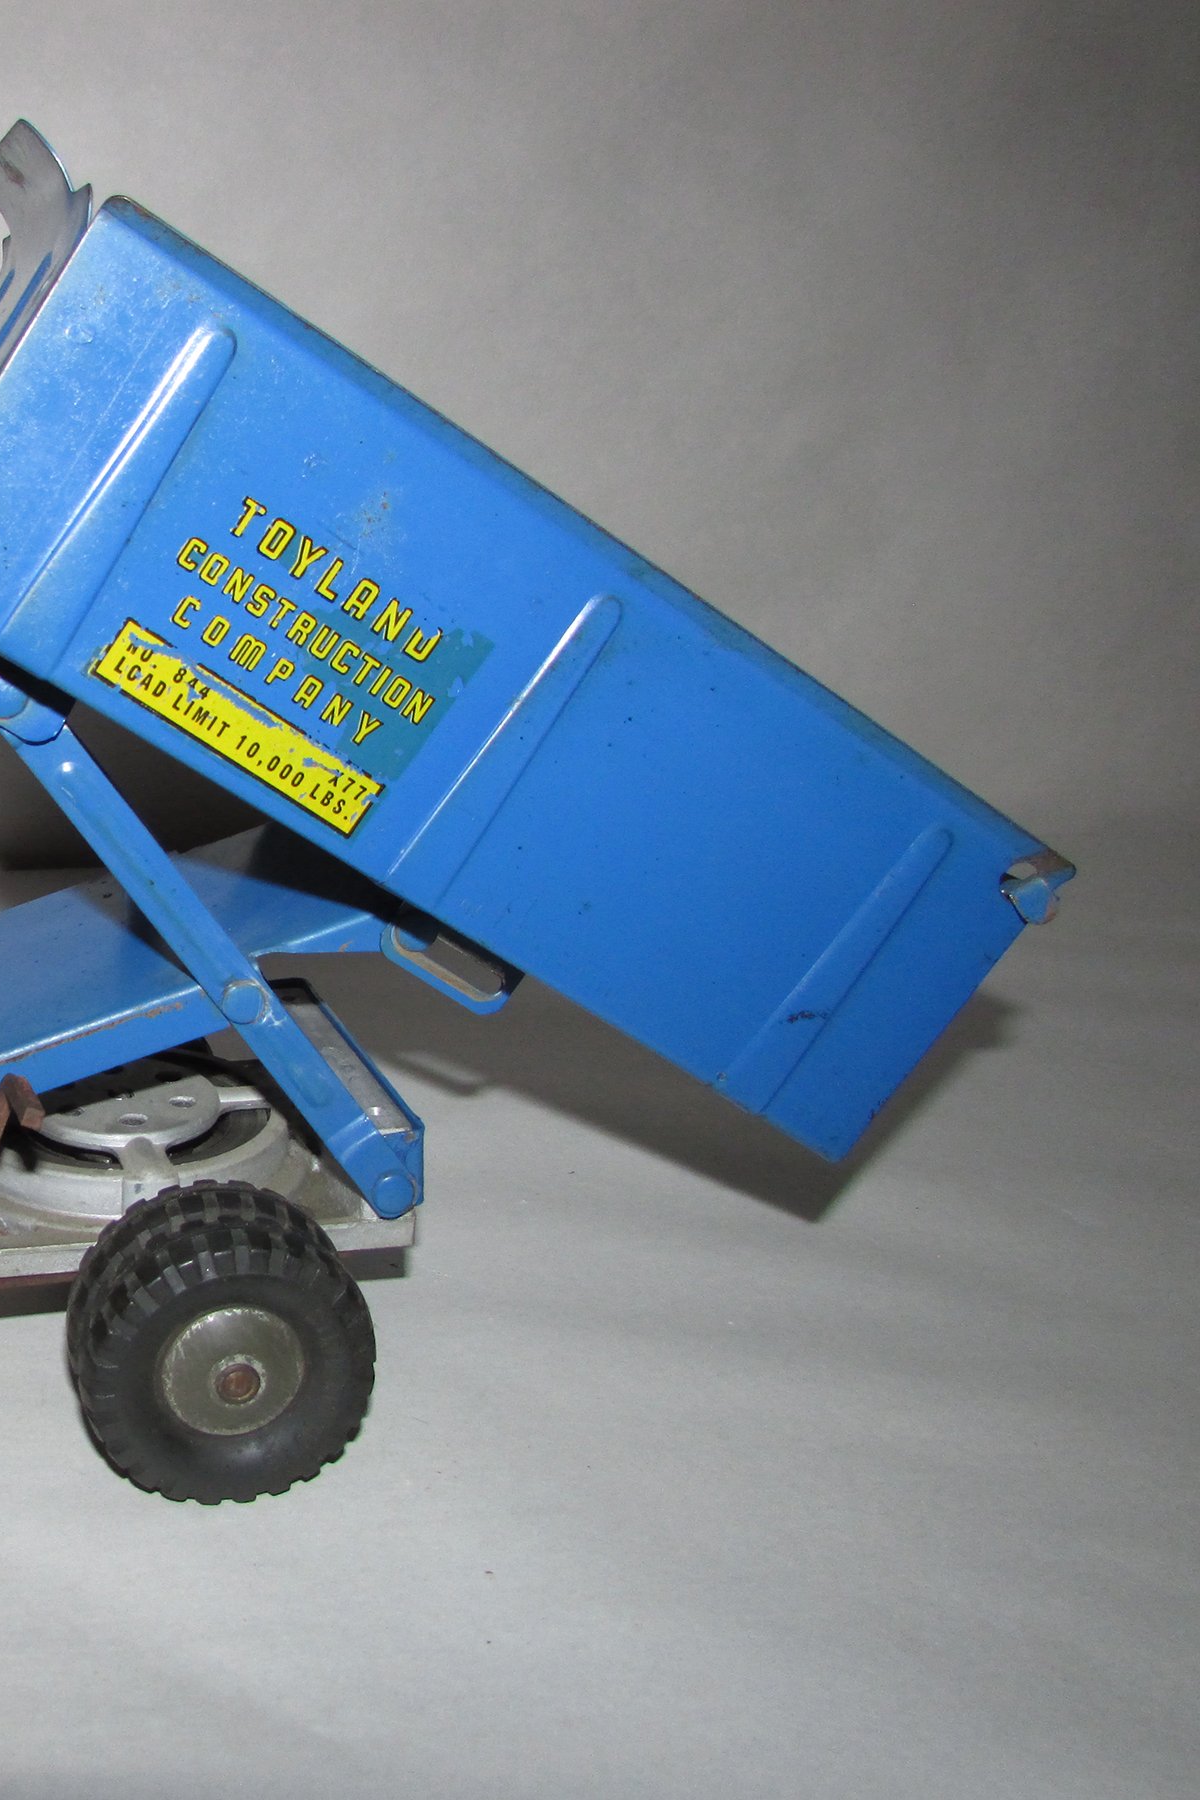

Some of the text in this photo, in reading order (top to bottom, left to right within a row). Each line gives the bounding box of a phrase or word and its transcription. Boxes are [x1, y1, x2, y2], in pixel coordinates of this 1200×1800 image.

[176, 537, 435, 725] CONSTRUCTION
[230, 496, 443, 662] TOYLAND
[170, 596, 385, 746] COMPANY
[173, 667, 211, 700] 844
[171, 693, 230, 737] LIMIT
[236, 735, 305, 787] 10,000
[309, 783, 349, 820] LBS.
